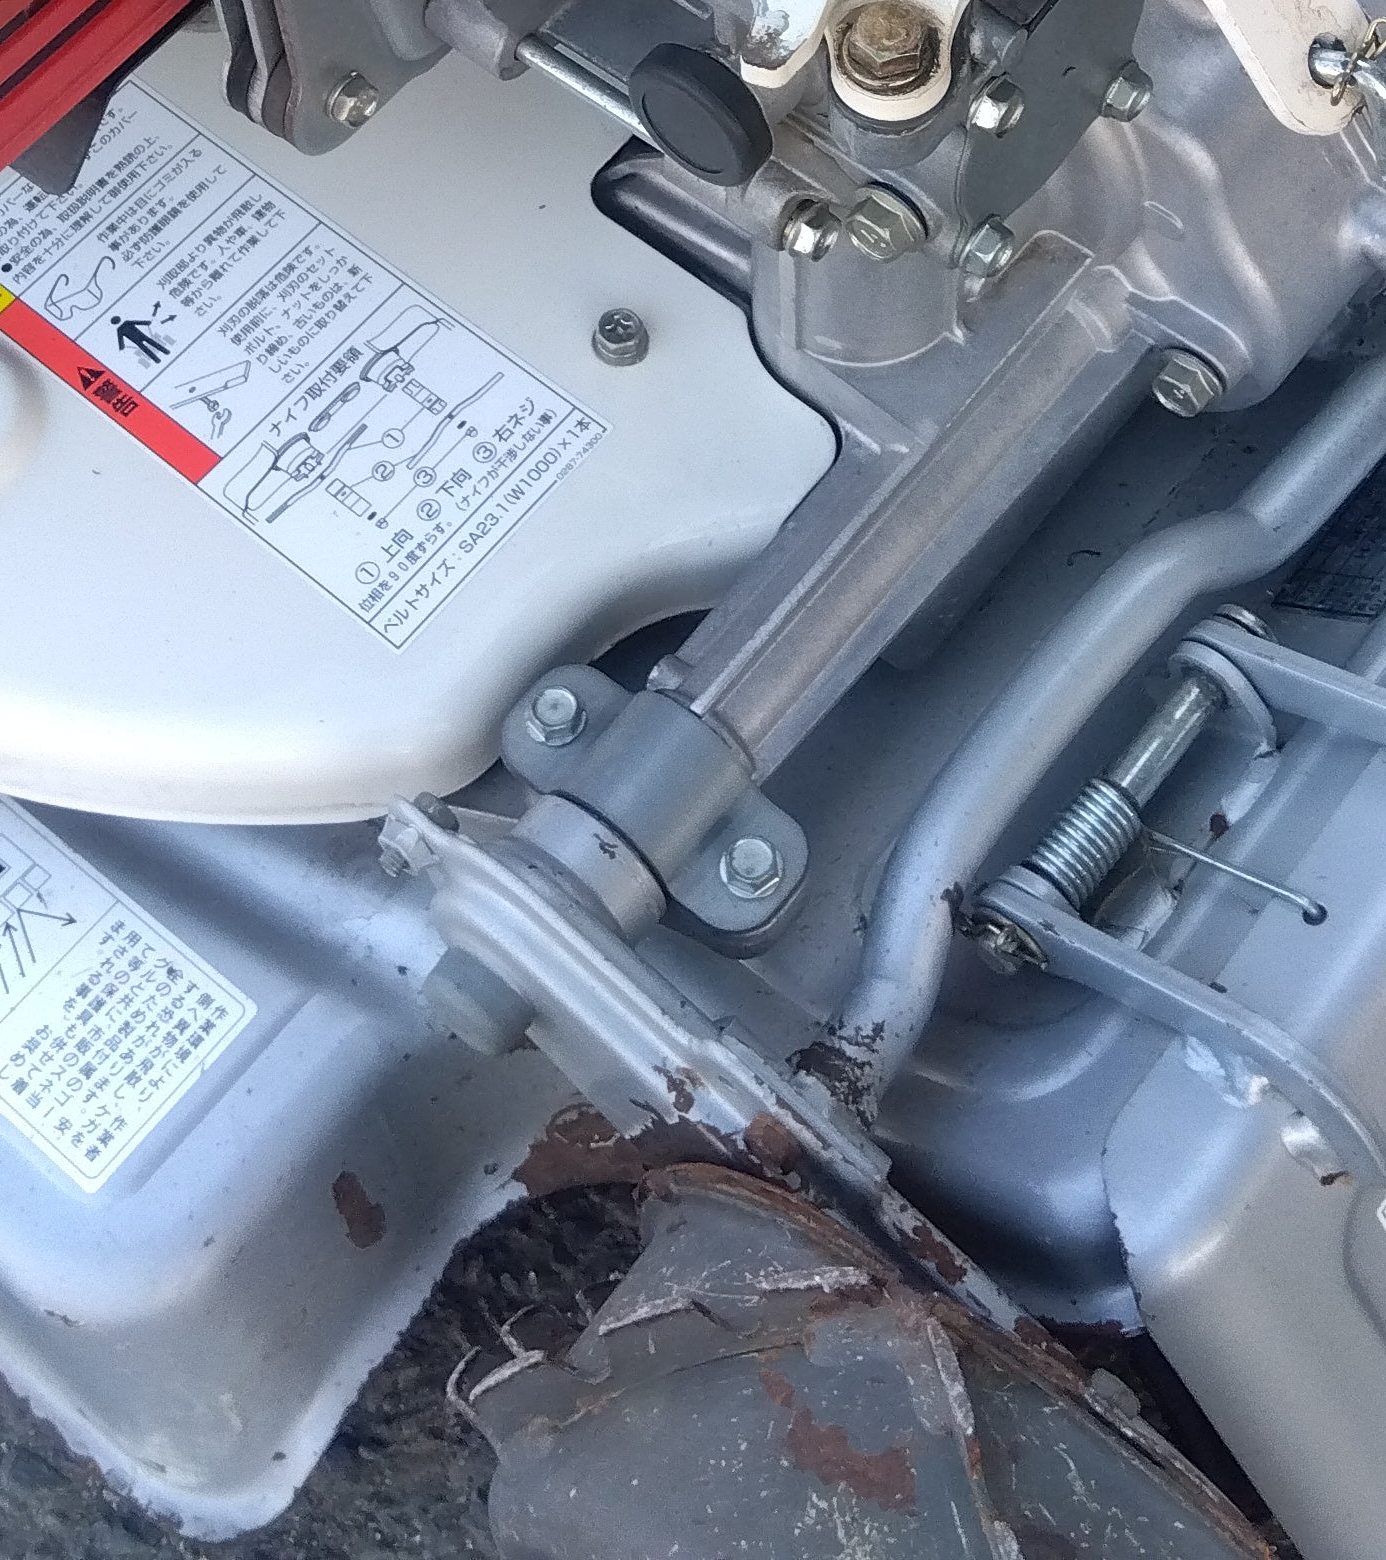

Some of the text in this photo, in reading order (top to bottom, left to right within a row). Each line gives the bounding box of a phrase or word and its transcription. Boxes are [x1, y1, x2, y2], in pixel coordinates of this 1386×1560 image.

[11, 143, 173, 285] 内容を十分に理解して御使用下さい。
[95, 147, 203, 244] 作業中は目にゴミが入る
[106, 195, 174, 253] 事があります。
[155, 192, 263, 291] 刈取部より異物が飛散し
[129, 239, 171, 269] 下さい。
[178, 207, 286, 307] 等から離れて作業して下
[216, 243, 321, 338] 刈刃の脱落は危険です。
[192, 294, 222, 317] さい。
[267, 271, 373, 374] しいものに取り替えて下
[91, 377, 139, 418] 警告
[267, 344, 365, 438] ナイフ取付要領
[279, 360, 310, 384] さい。
[379, 527, 415, 564] 上向
[433, 466, 473, 498] 下向
[490, 395, 535, 443] 右ネジ
[554, 431, 604, 481] 0287-74300
[88, 918, 127, 956] ます。
